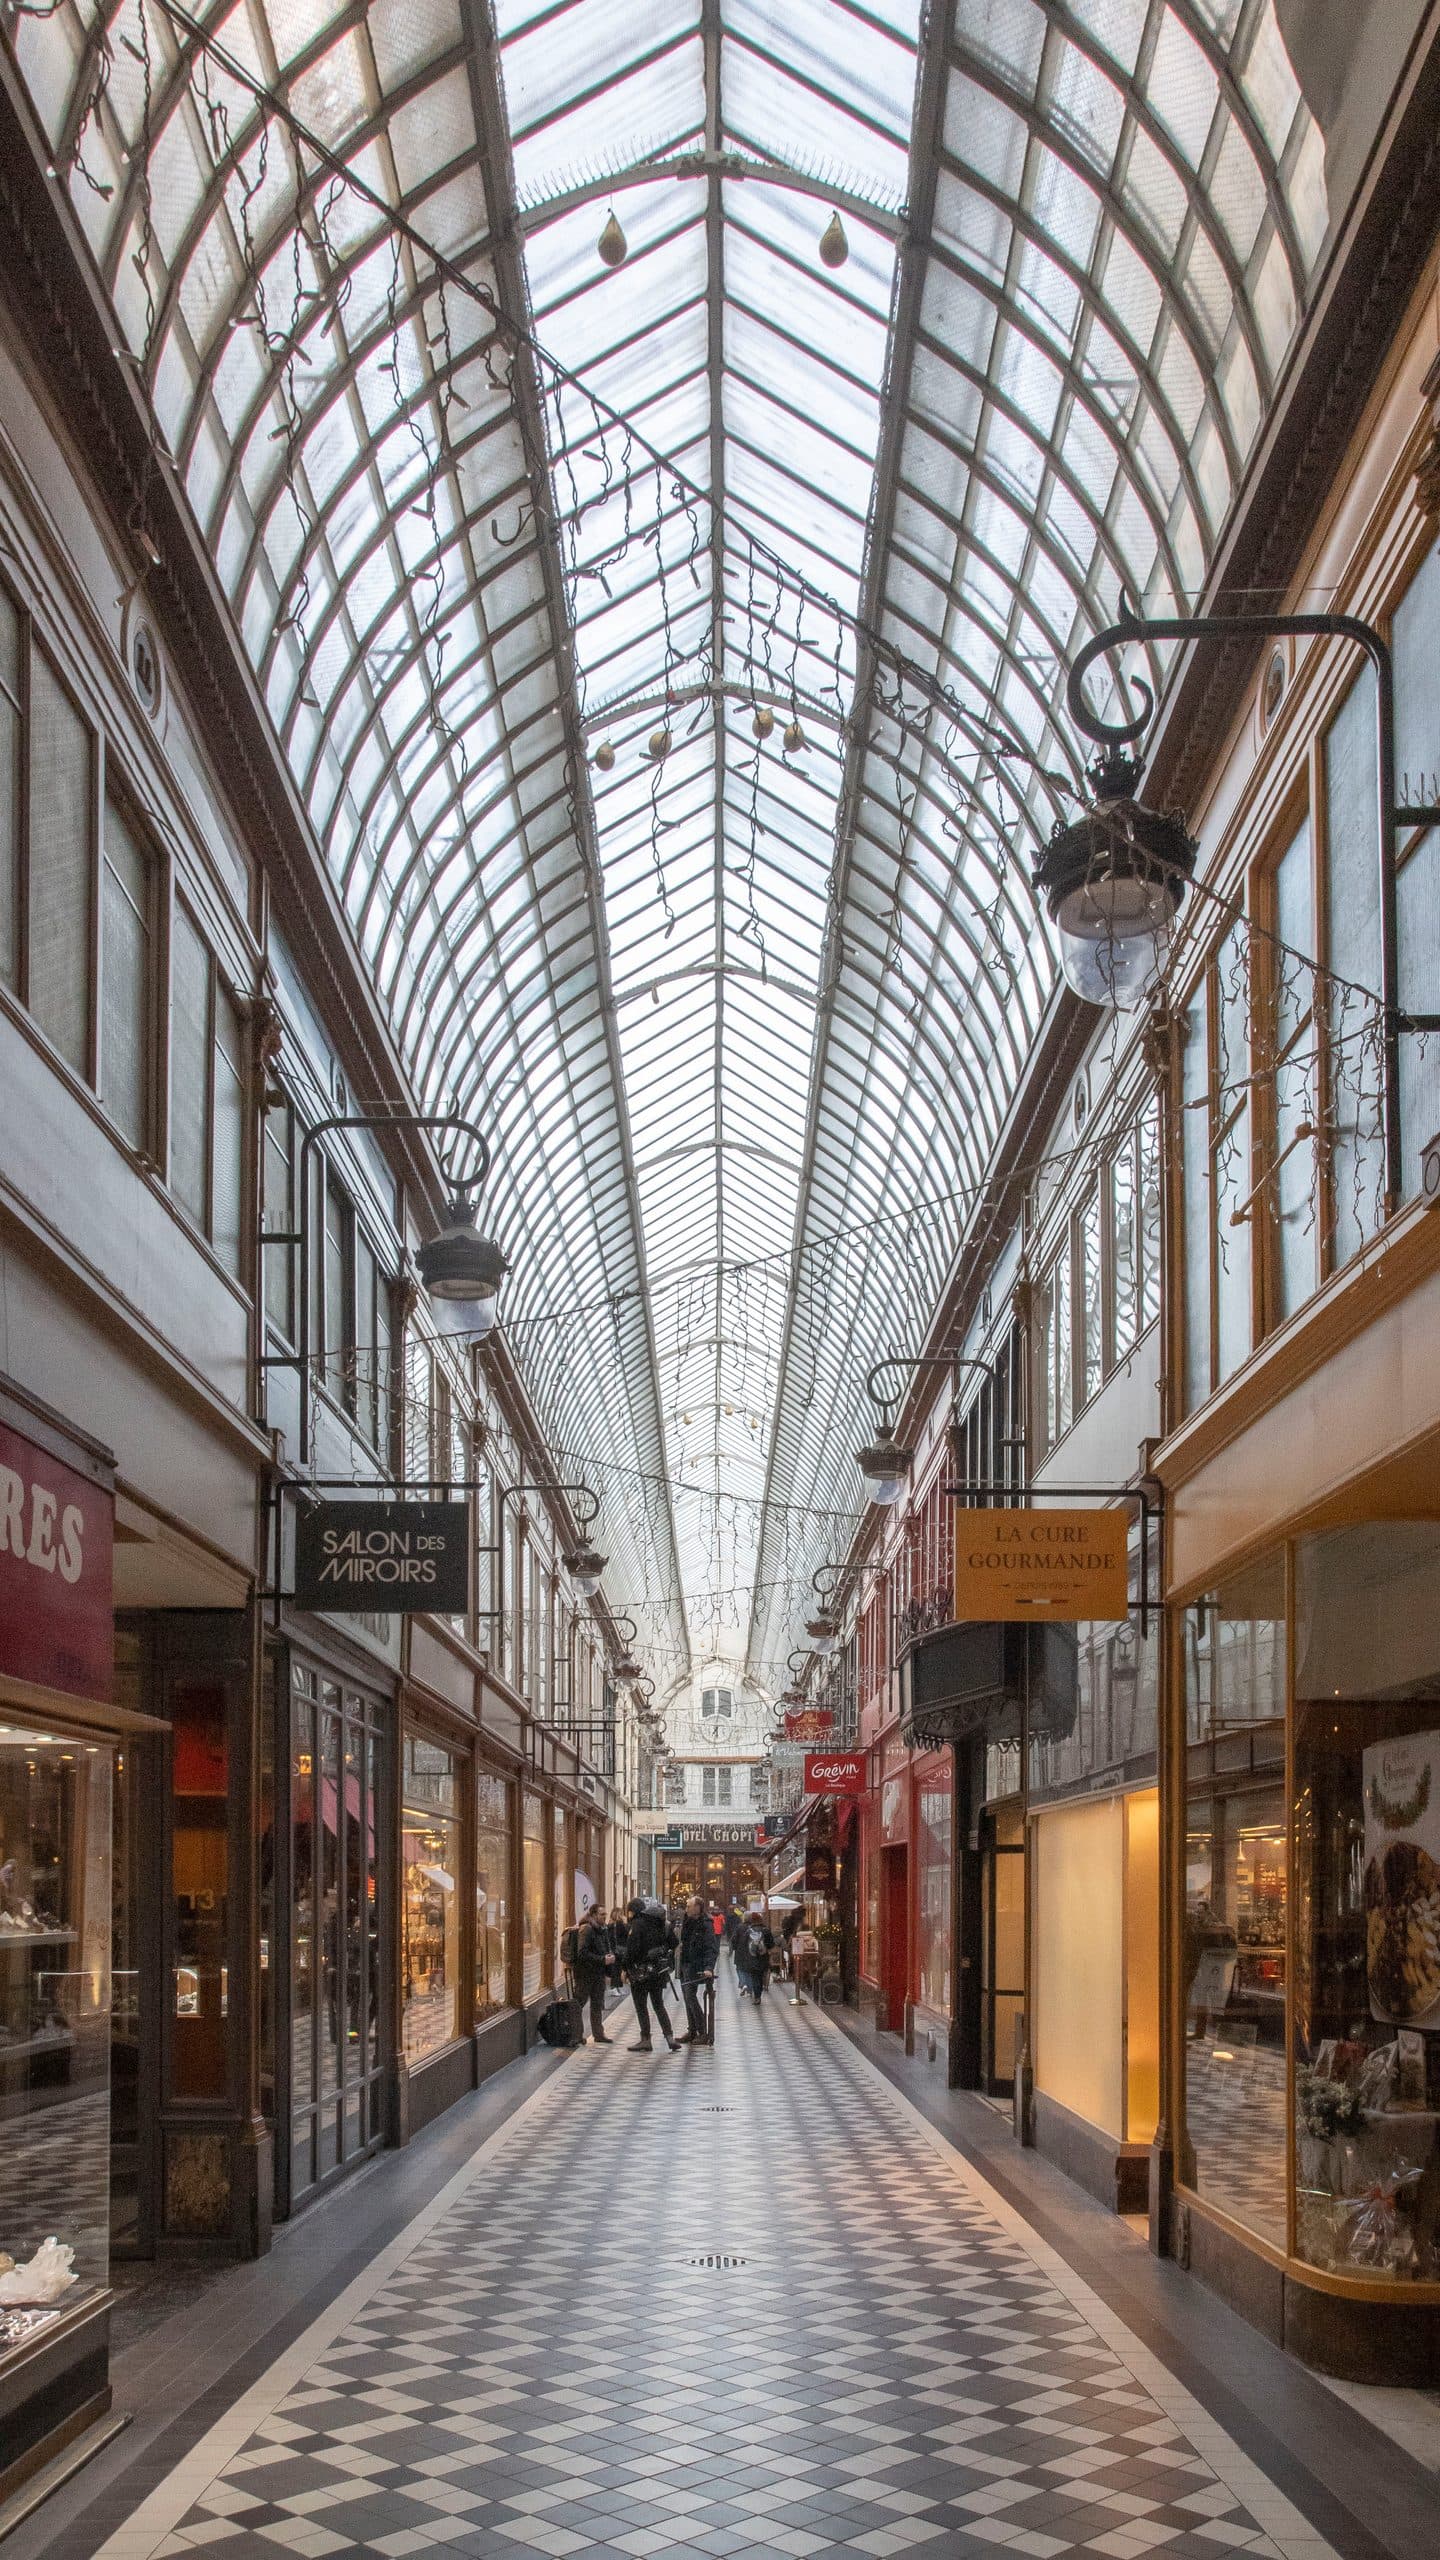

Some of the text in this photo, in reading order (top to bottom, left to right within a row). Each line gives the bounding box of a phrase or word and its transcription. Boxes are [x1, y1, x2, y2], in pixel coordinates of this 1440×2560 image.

[323, 1530, 446, 1555] SALON DES
[995, 1526, 1089, 1543] LA CURE
[318, 1557, 438, 1583] MIROIRS
[968, 1552, 1116, 1570] GOURMANDE
[811, 1762, 859, 1782] Grévin
[683, 1829, 752, 1842] OTEL CHOPI
